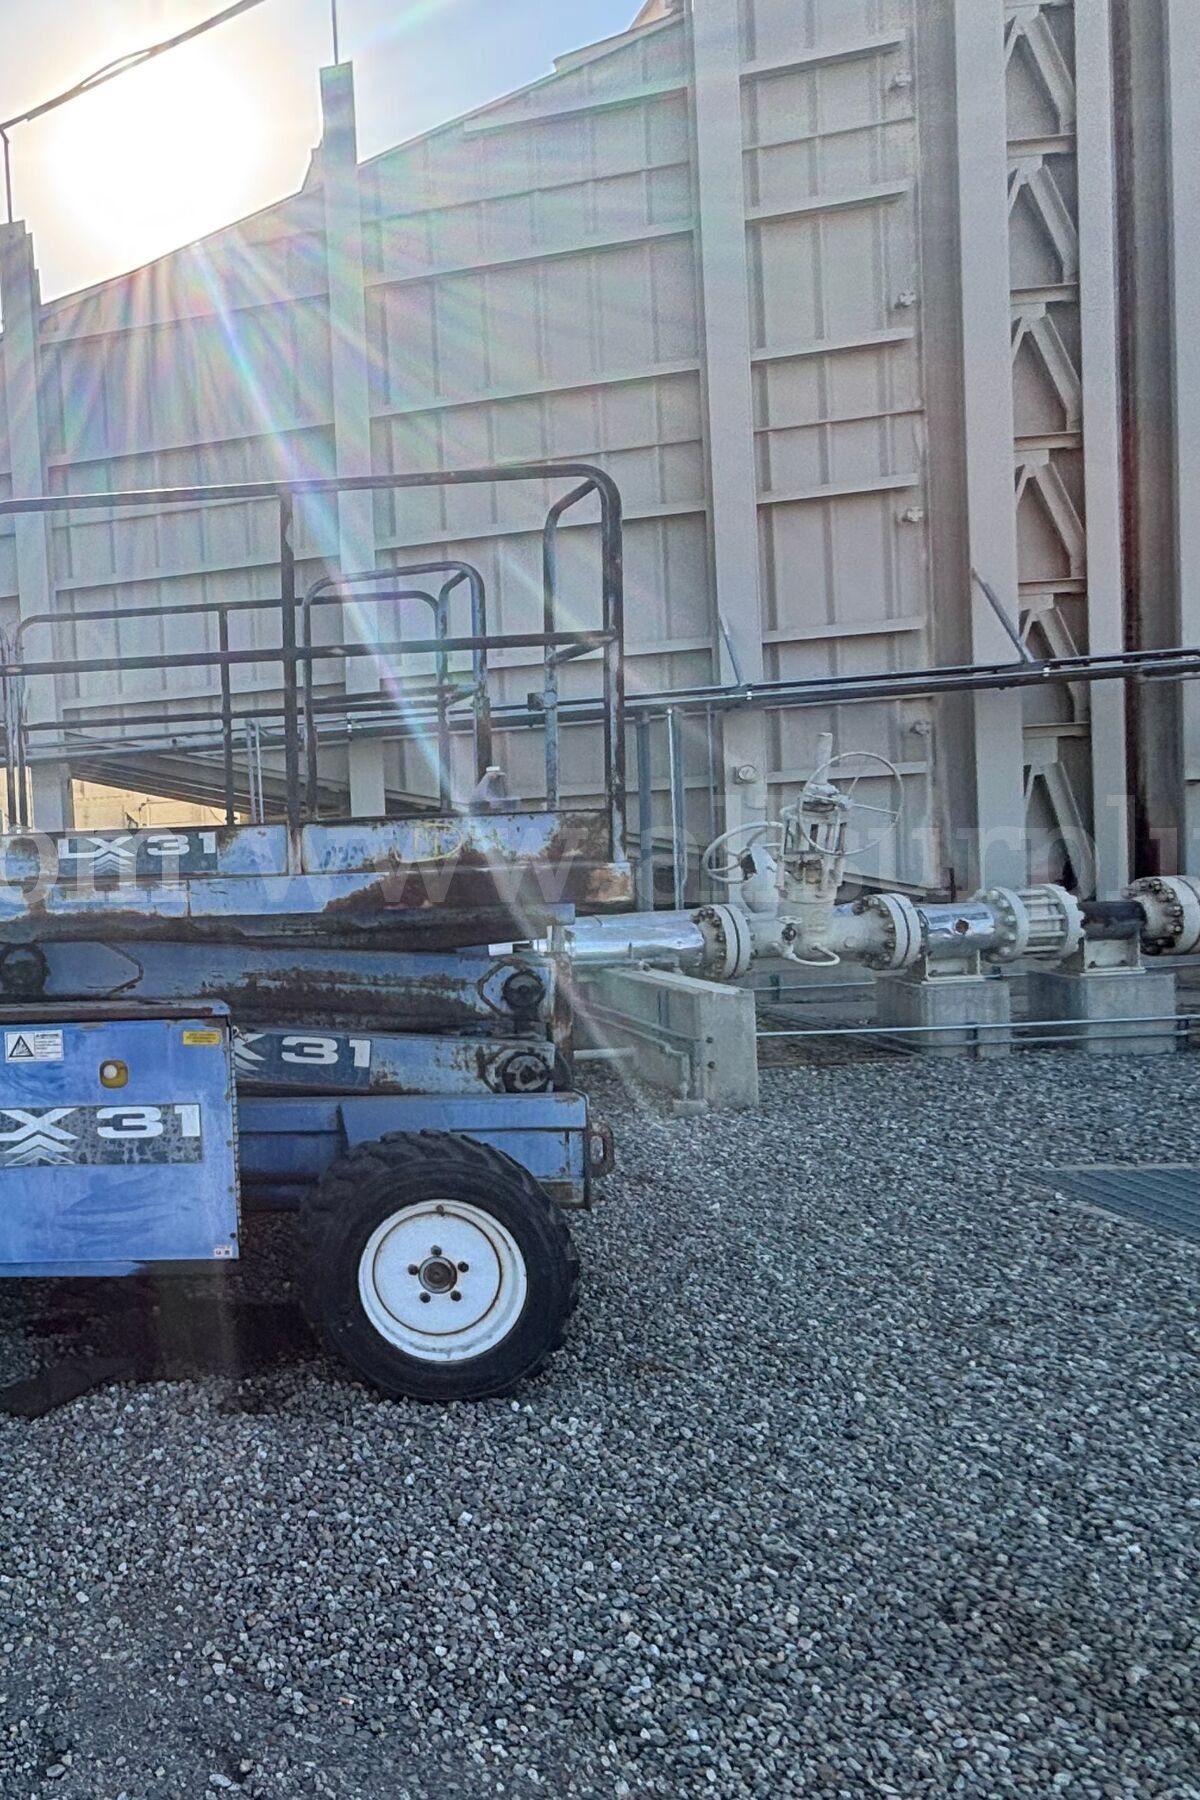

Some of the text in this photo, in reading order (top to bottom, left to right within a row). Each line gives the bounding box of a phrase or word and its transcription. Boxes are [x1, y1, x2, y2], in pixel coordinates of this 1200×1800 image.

[57, 831, 217, 860] LX 31
[280, 1035, 372, 1068] 31
[96, 1104, 201, 1139] 31
